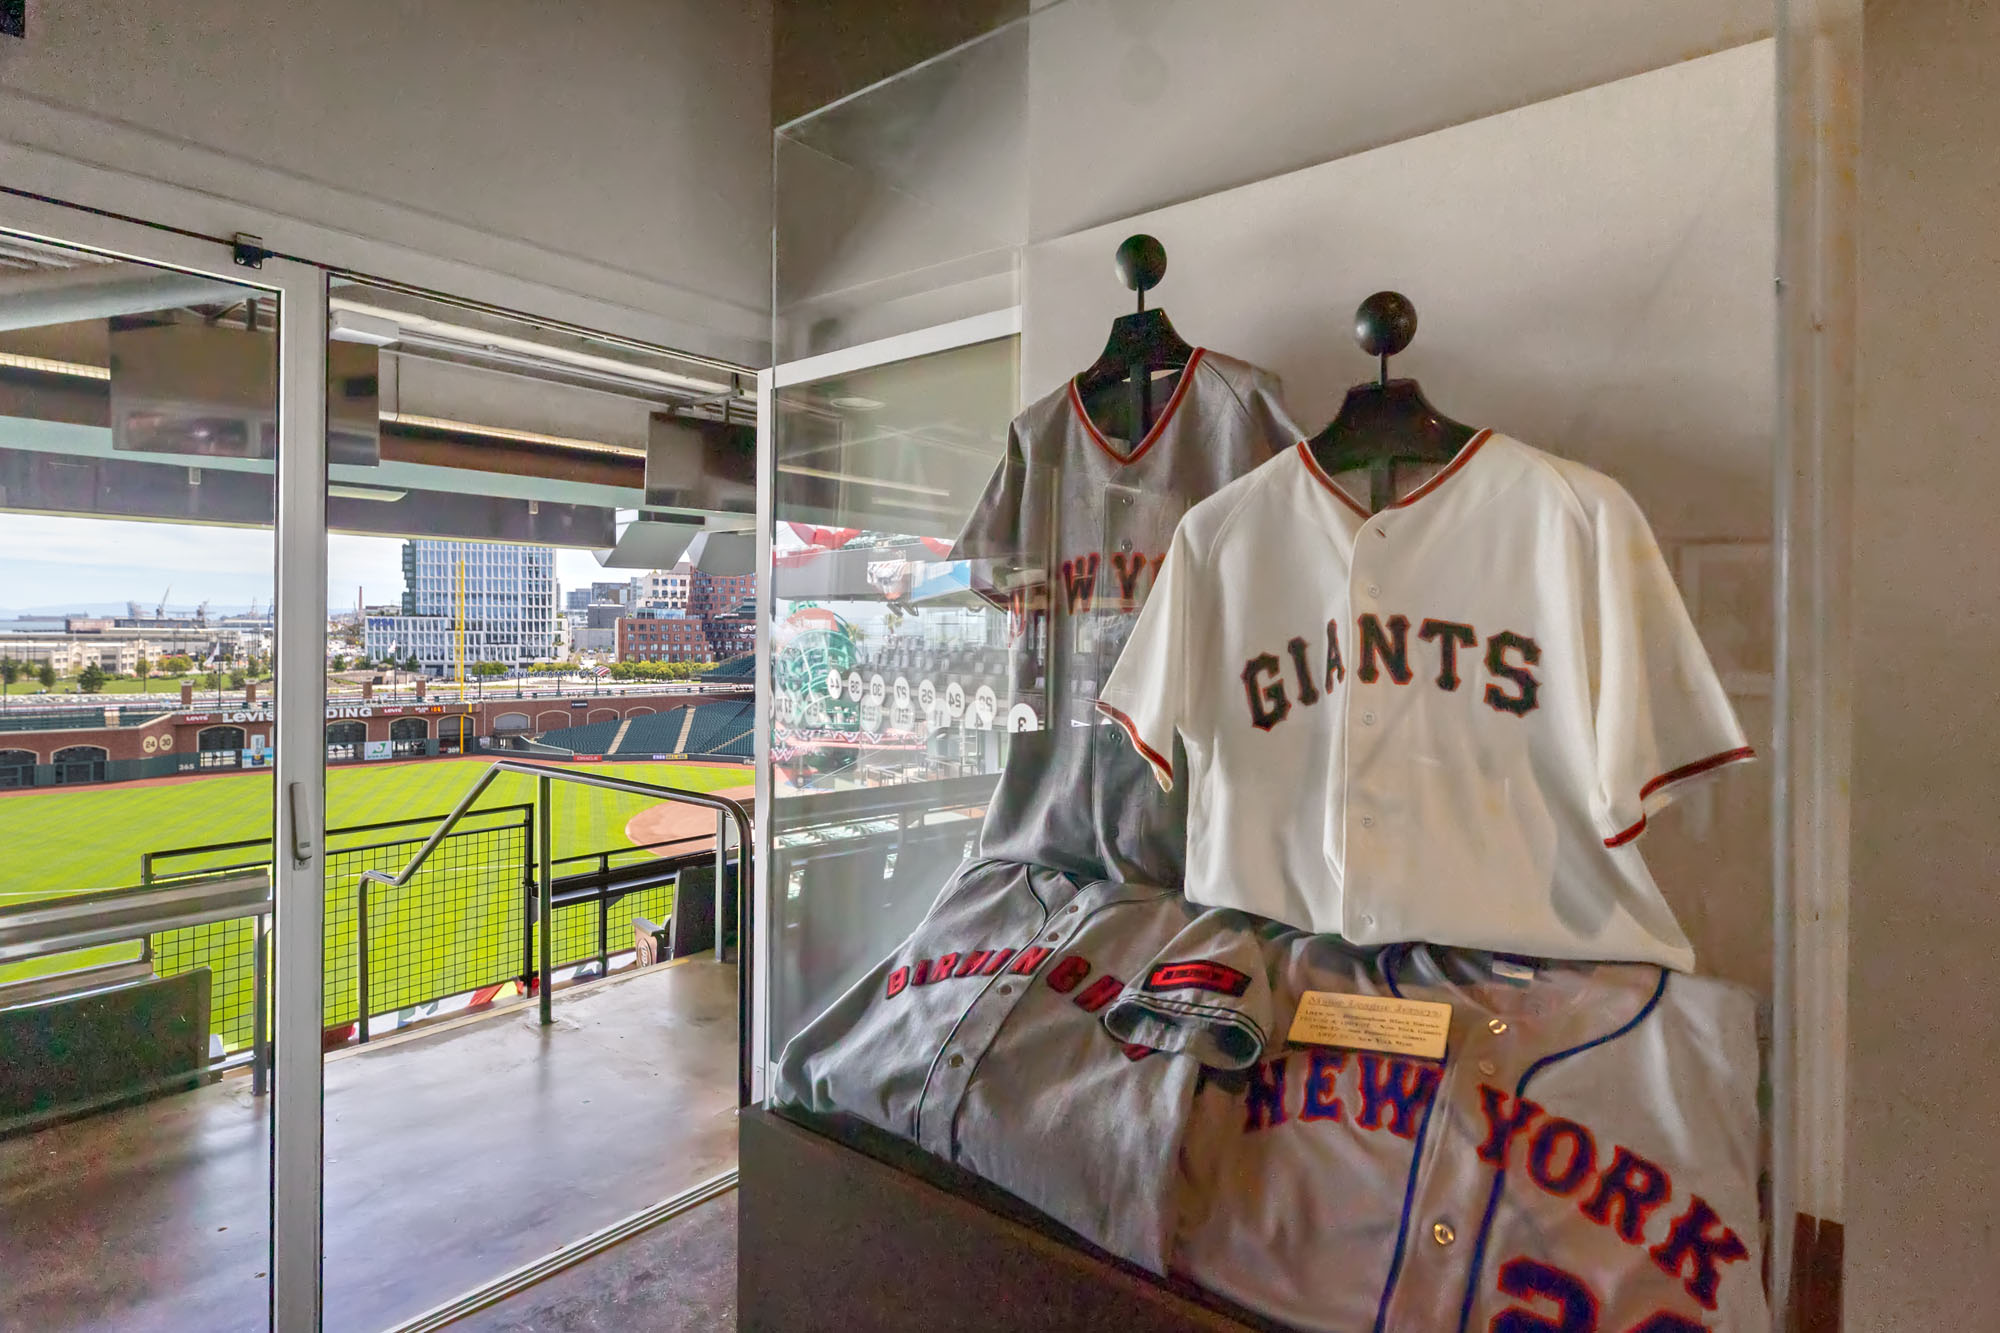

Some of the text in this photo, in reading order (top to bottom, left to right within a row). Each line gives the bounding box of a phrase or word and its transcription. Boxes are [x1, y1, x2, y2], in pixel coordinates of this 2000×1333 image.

[534, 670, 546, 678] OF
[548, 670, 590, 678] AMERICA
[1240, 613, 1543, 732] GIANTS
[326, 707, 373, 719] DING
[145, 740, 156, 748] 24
[161, 738, 172, 747] 30
[1242, 1052, 1749, 1310] NEW YORK
